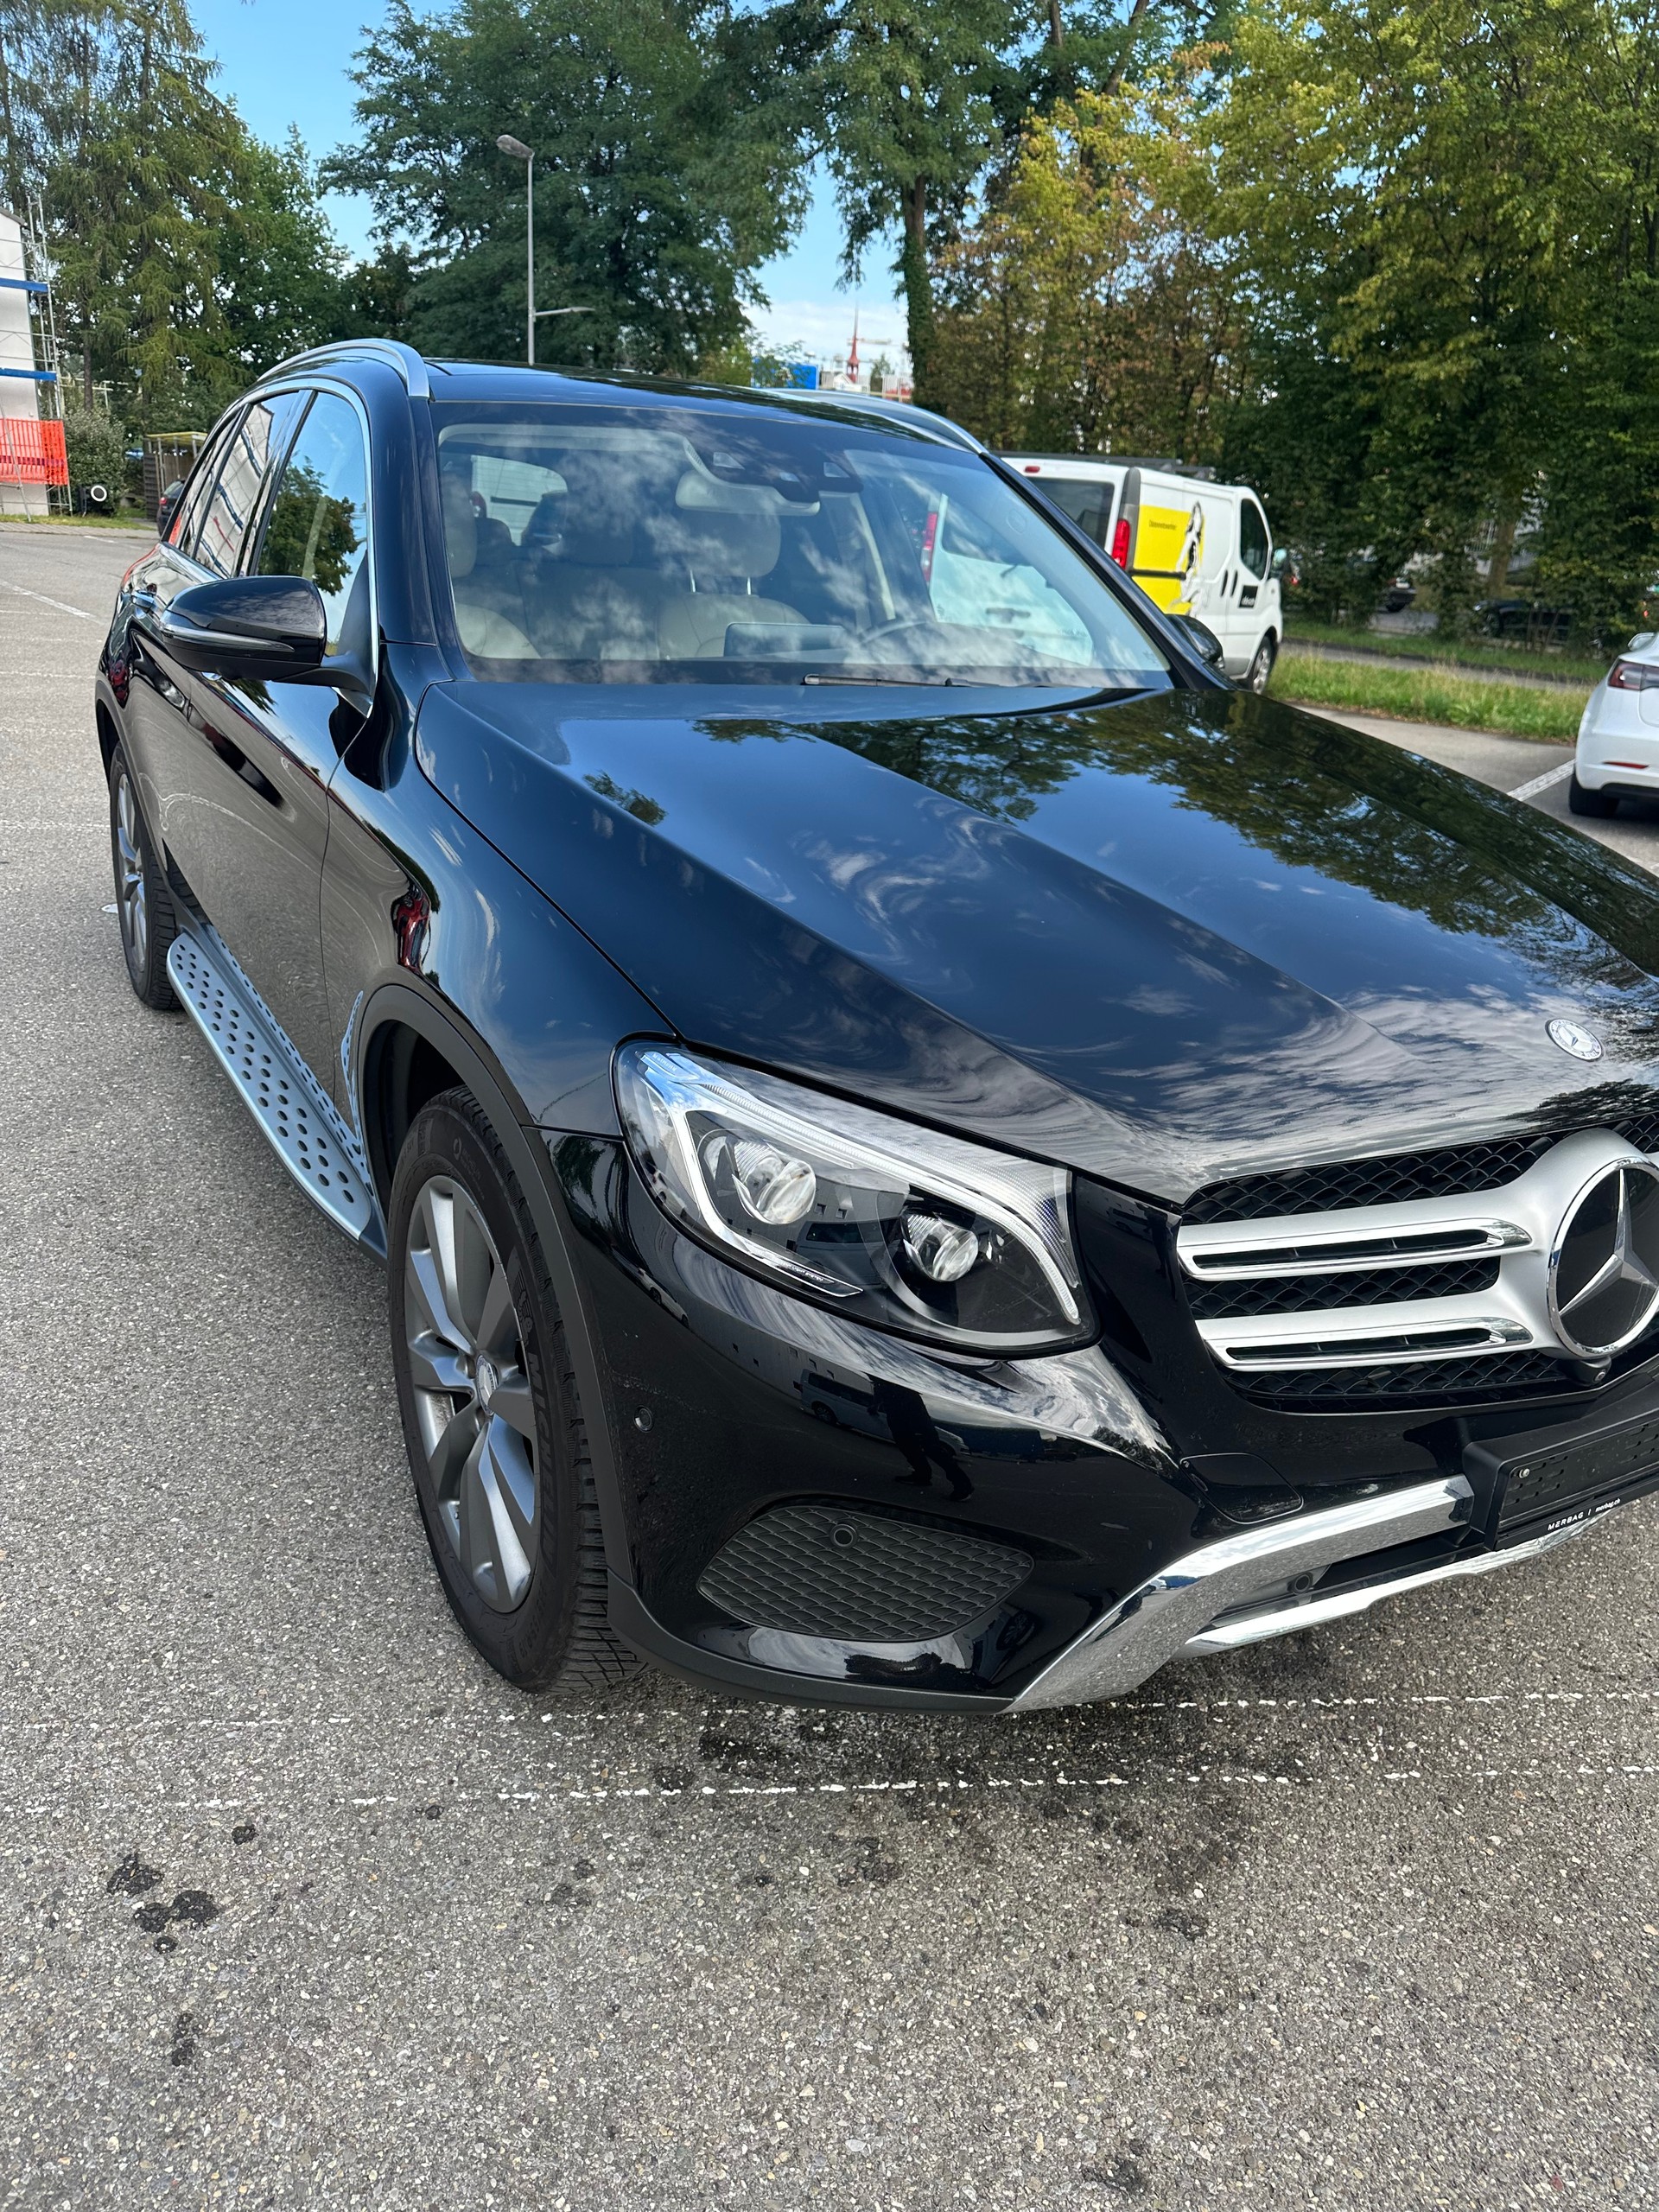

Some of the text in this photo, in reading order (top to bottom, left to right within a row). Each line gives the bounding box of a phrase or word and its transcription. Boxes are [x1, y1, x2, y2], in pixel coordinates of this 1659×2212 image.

[527, 1351, 557, 1567] MICHELIN
[1548, 1512, 1584, 1531] MERBAG
[1595, 1498, 1621, 1513] merbag.ch
